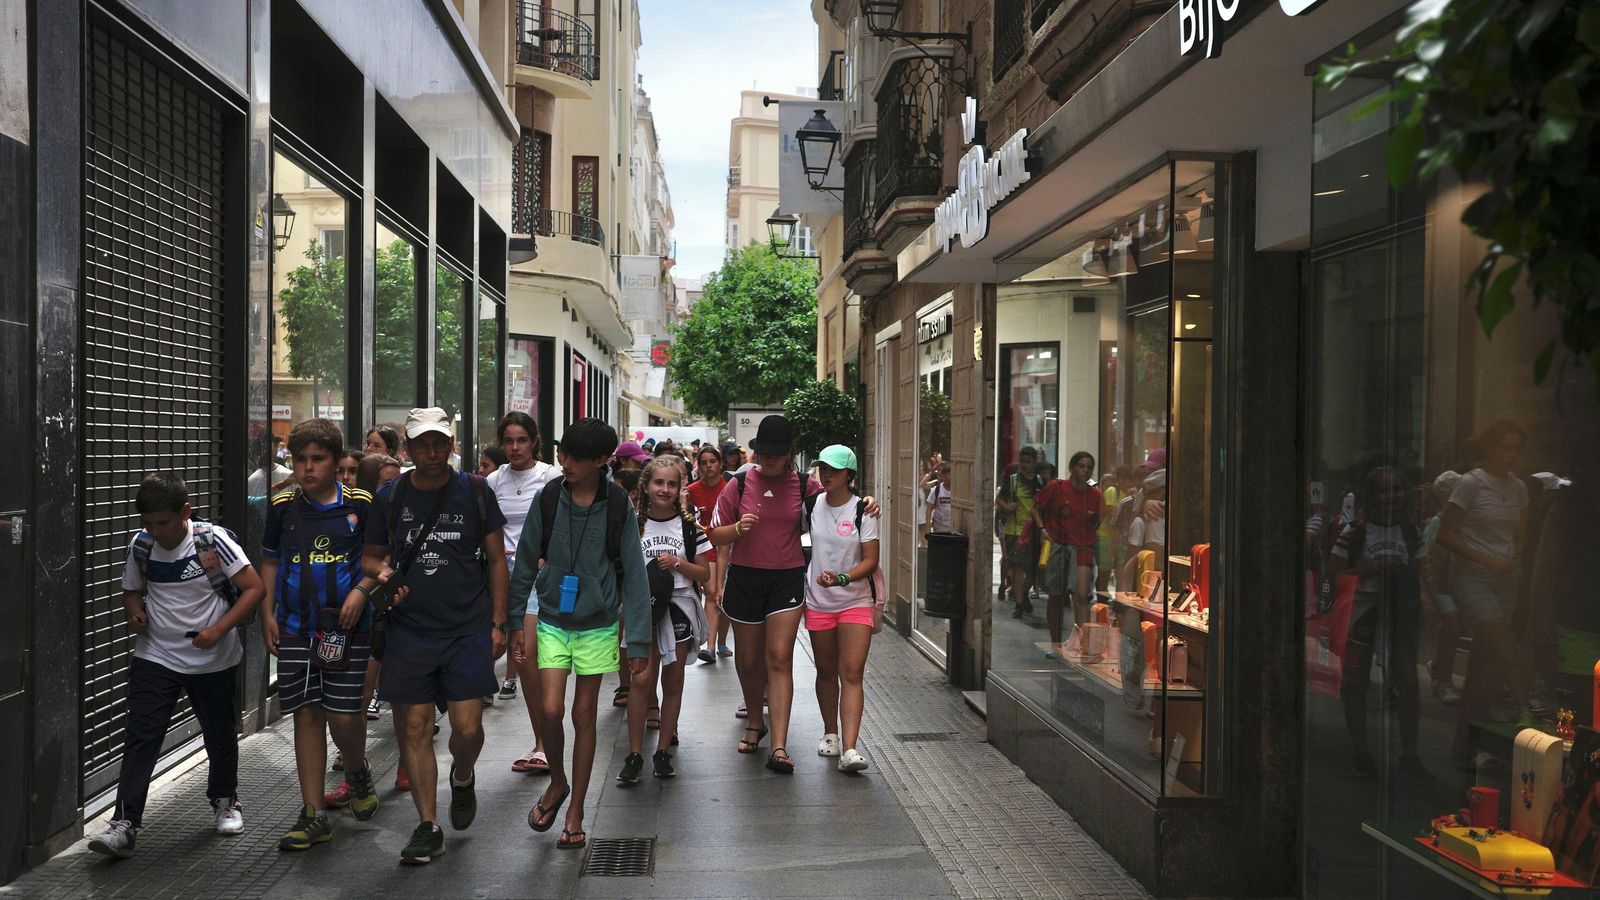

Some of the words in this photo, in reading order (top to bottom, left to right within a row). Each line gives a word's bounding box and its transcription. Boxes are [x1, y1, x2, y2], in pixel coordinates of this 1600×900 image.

[453, 514, 464, 524] 22
[652, 535, 683, 551] FRANCISCO
[291, 550, 349, 565] dfabet
[427, 558, 449, 566] PEDRO
[320, 643, 339, 659] NFL
